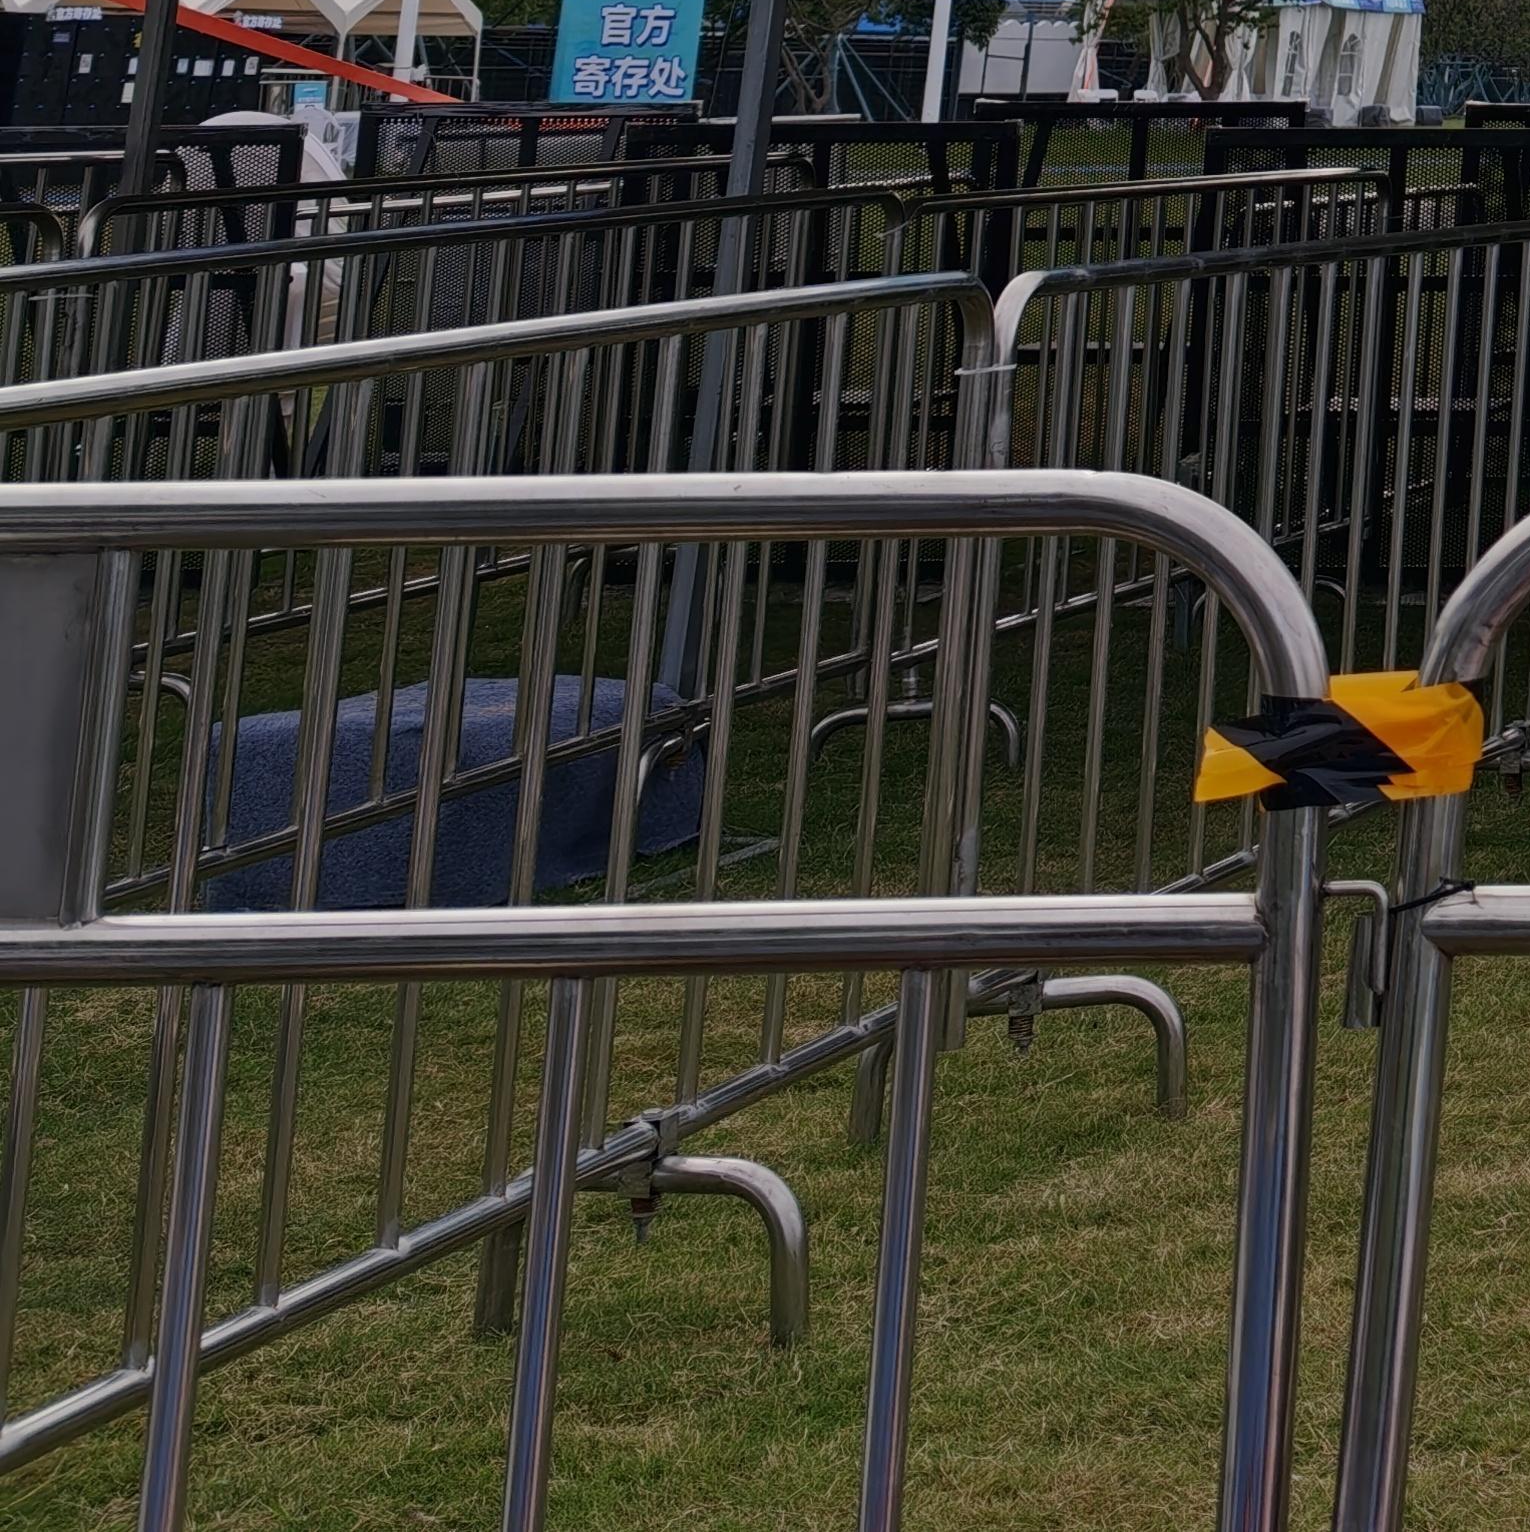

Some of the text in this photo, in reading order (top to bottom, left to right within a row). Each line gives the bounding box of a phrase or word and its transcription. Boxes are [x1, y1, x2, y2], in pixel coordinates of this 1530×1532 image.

[601, 3, 675, 46] 官方
[573, 55, 686, 97] 寄存处
